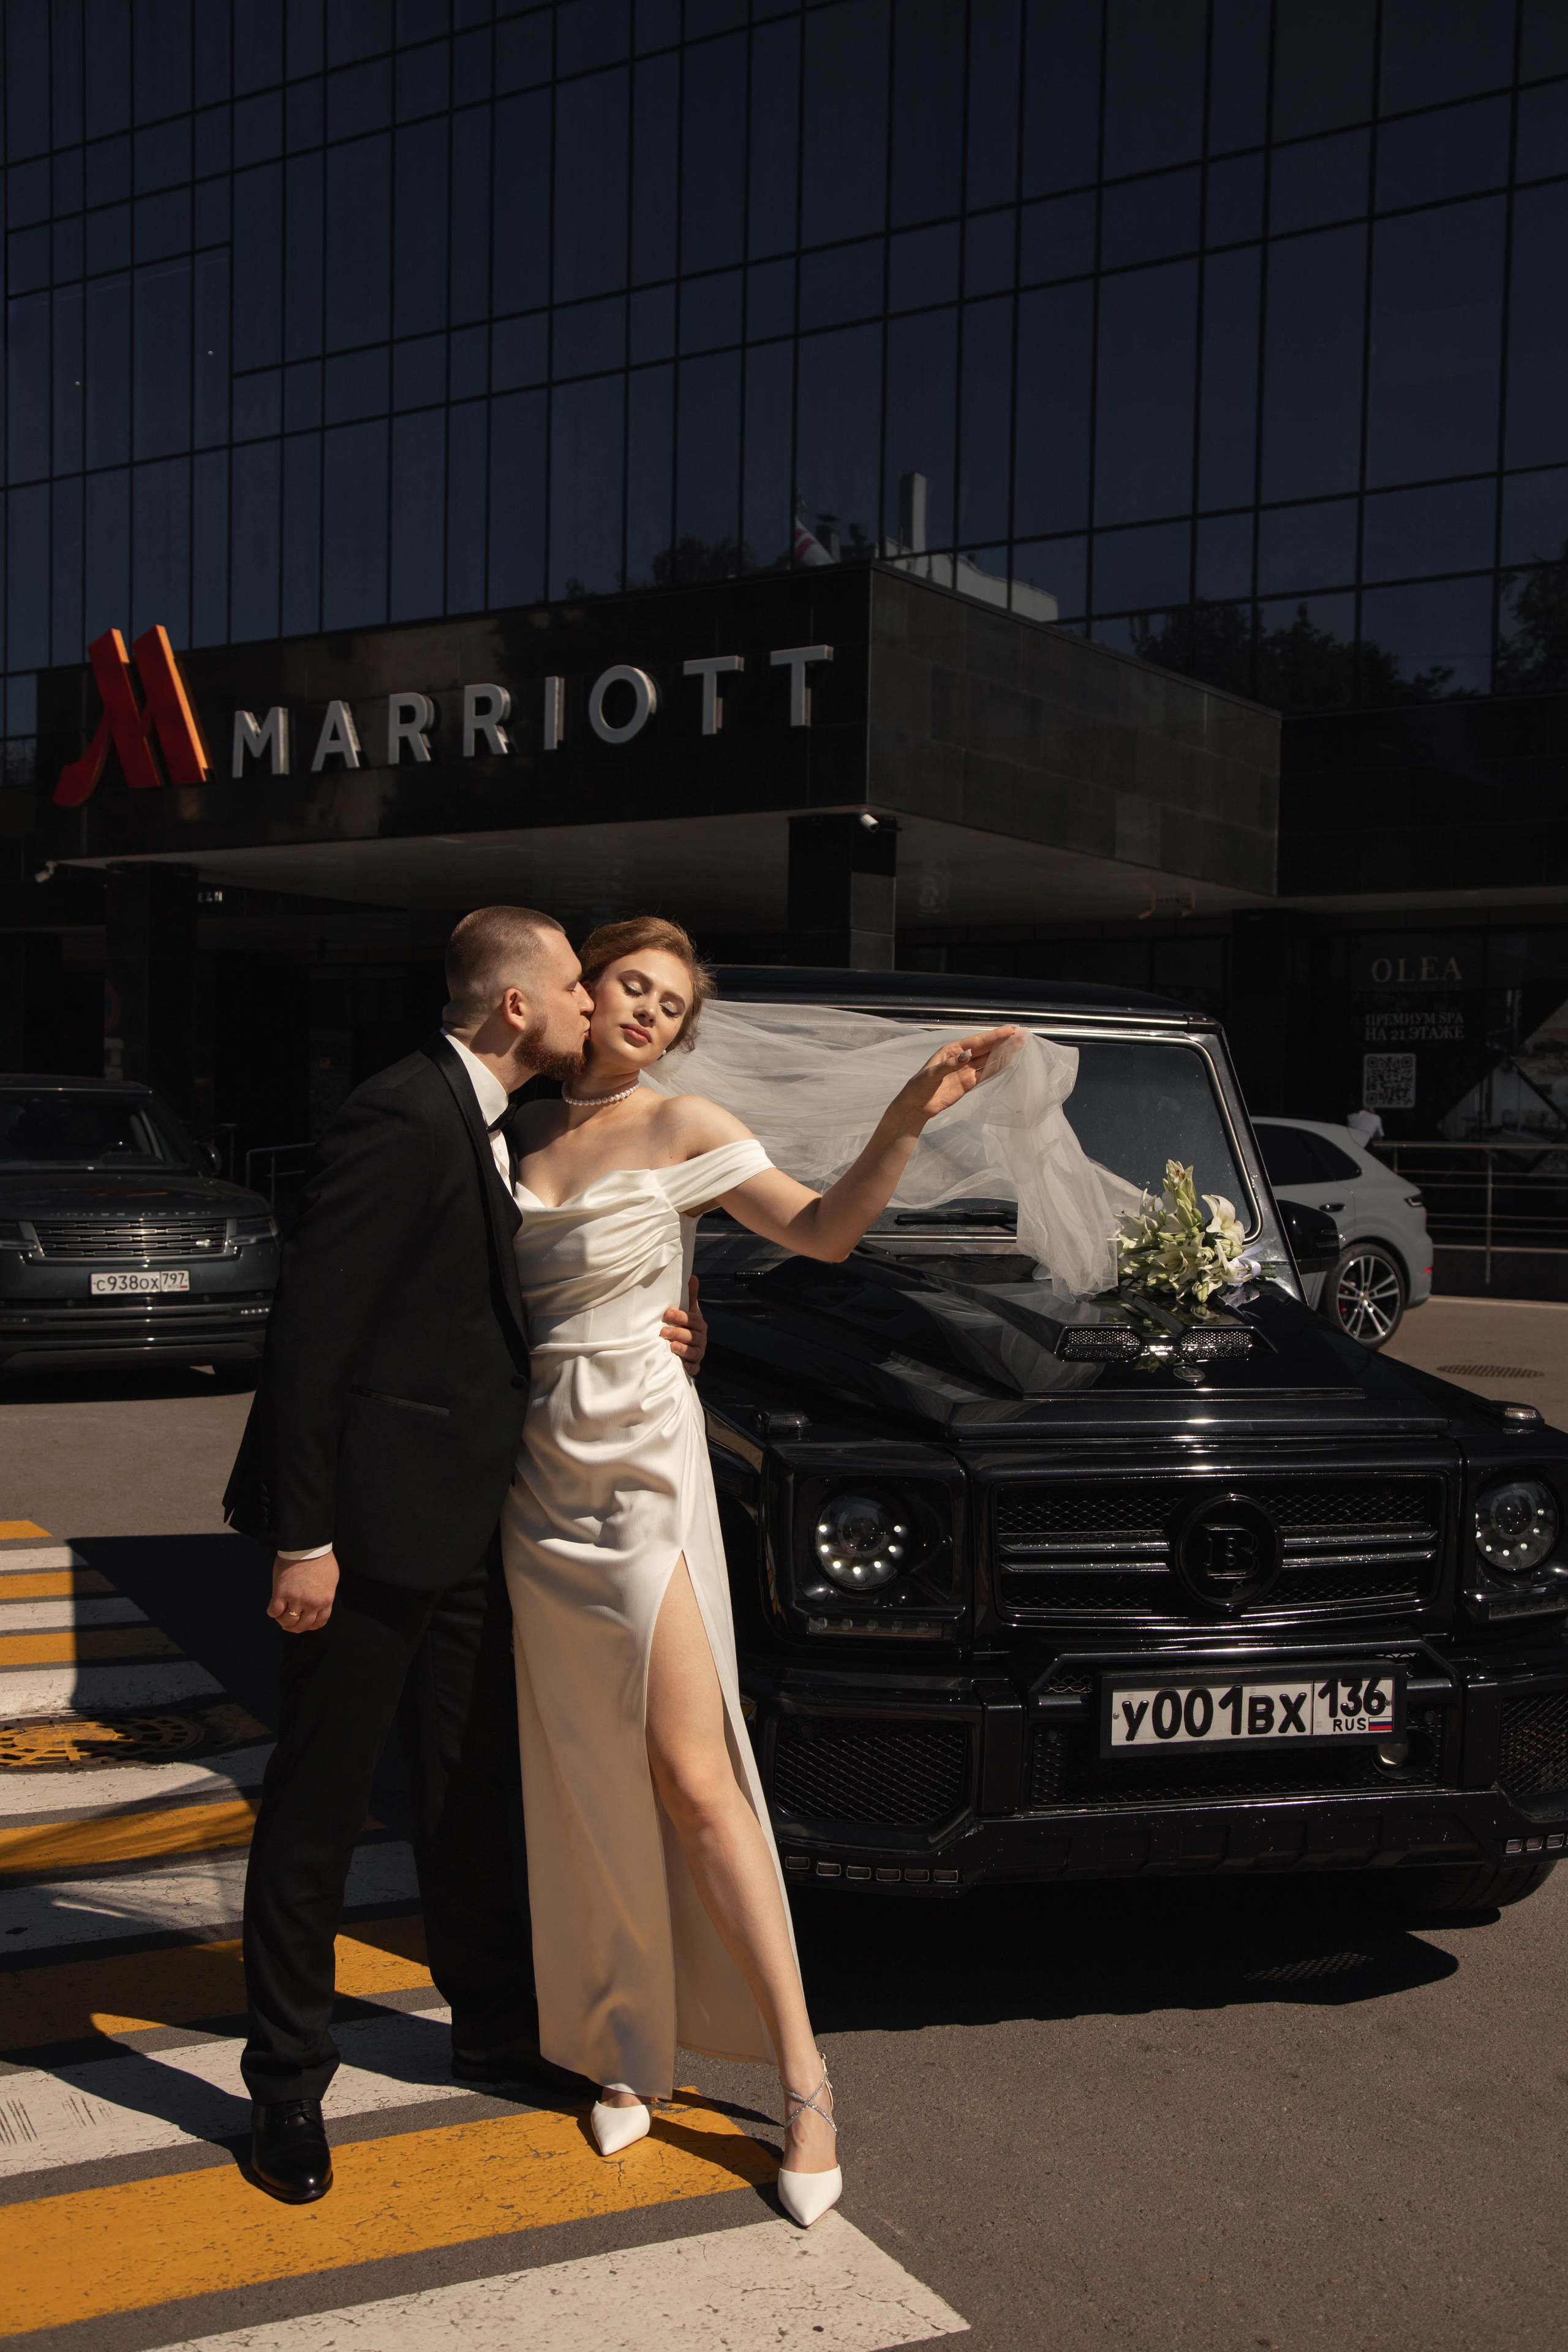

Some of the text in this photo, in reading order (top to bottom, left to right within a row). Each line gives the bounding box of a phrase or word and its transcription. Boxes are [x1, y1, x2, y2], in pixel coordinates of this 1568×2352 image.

[232, 644, 834, 779] MARRIOTT
[1371, 956, 1463, 982] OLEA
[1365, 1011, 1464, 1026] ПРЕМИУМ SPA
[1365, 1025, 1464, 1041] НА 21 ЭТАЖЕ
[162, 1273, 184, 1284] 797
[1318, 1678, 1385, 1717] 136
[1333, 1717, 1366, 1732] RUS
